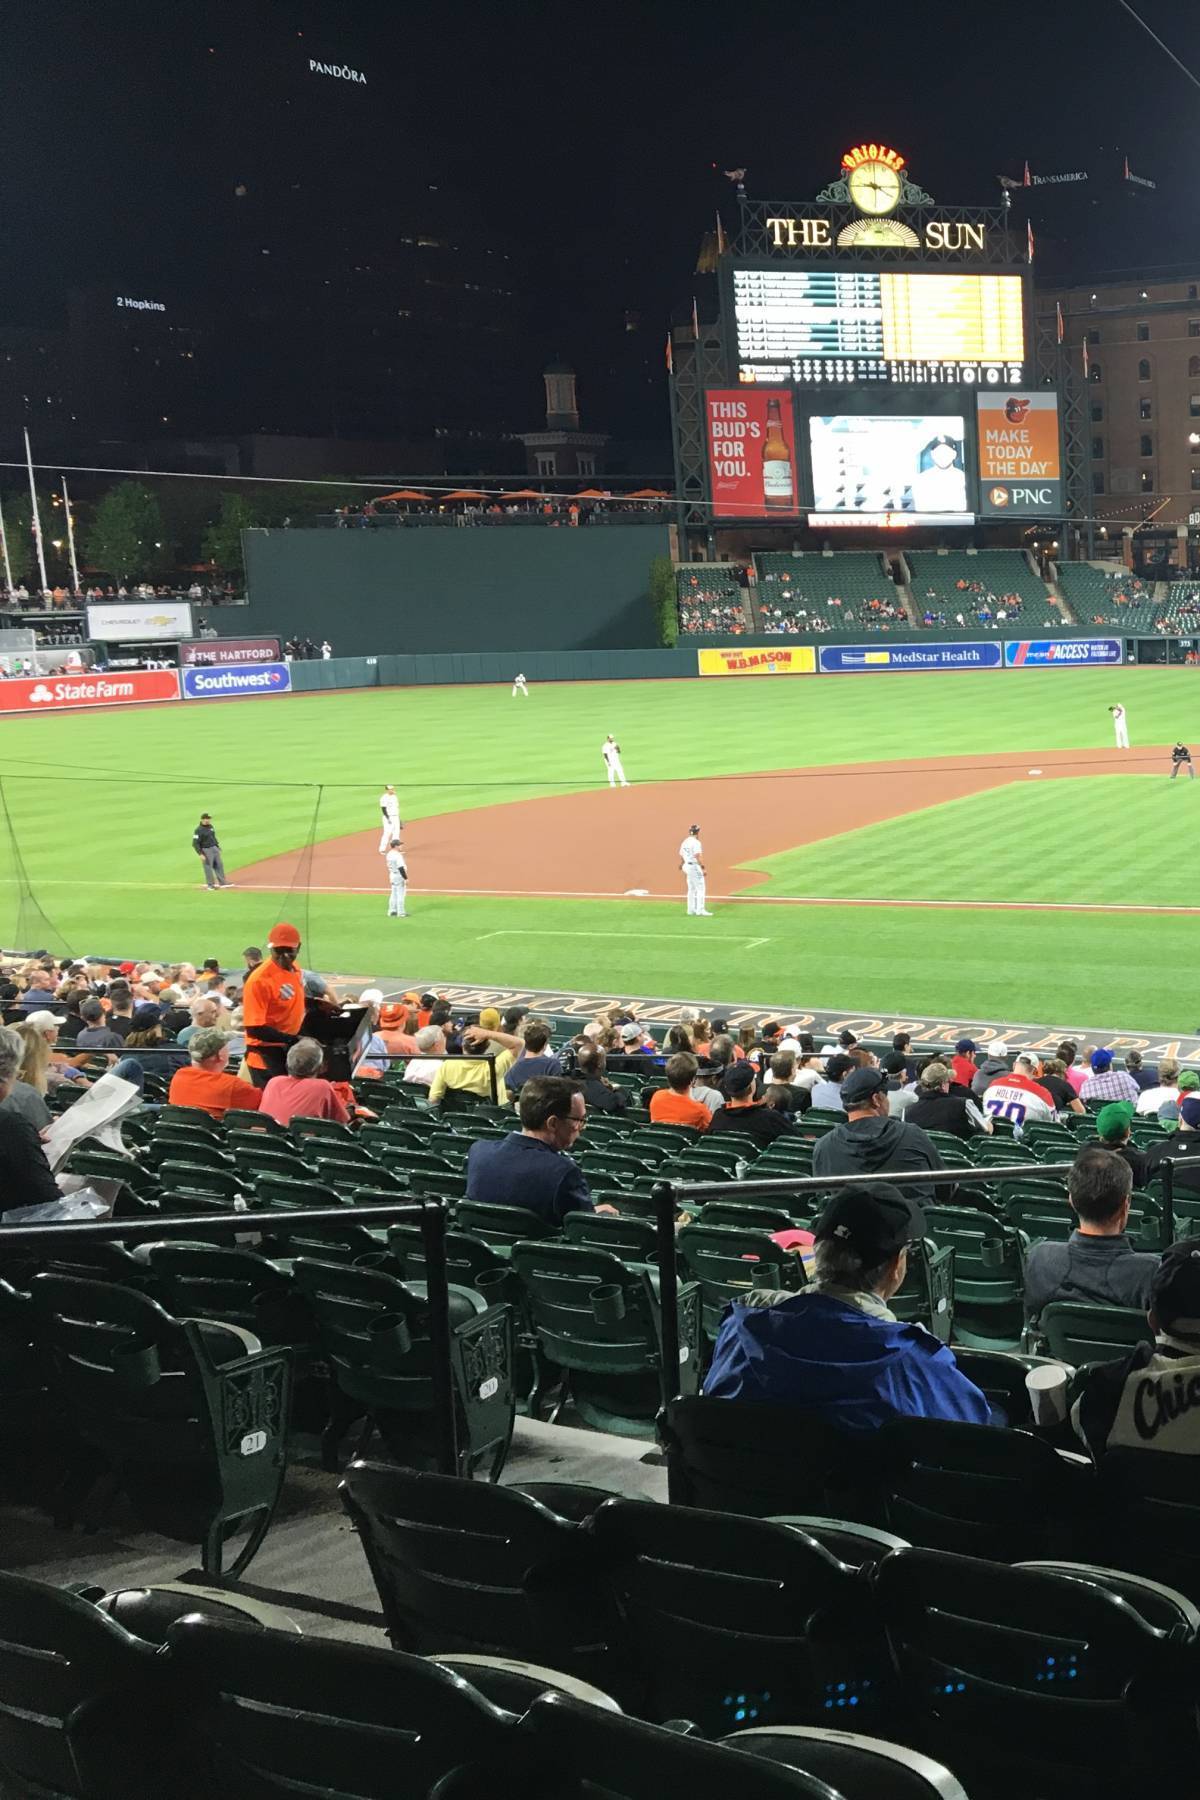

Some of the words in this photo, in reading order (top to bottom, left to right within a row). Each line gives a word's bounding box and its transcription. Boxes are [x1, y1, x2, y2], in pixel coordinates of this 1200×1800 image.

[309, 59, 367, 85] PANDORA
[843, 144, 905, 170] ORIOLES
[1031, 171, 1089, 186] TRANSAMERICA
[766, 218, 832, 247] THE
[925, 221, 985, 250] SUN
[116, 296, 124, 307] 2
[124, 297, 166, 311] Hopkins
[710, 402, 747, 418] THIS
[712, 421, 761, 438] BUD'S
[985, 430, 1030, 444] MAKE
[713, 441, 745, 457] FOR
[986, 446, 1034, 459] TODAY
[714, 461, 751, 477] YOU.
[987, 462, 1016, 475] THE
[1011, 488, 1053, 504] PNC
[220, 649, 274, 660] HARTFORD
[892, 651, 939, 663] MedStar
[941, 649, 980, 661] Health
[1053, 644, 1089, 659] ACCESS
[194, 672, 271, 690] Southwest
[726, 1010, 816, 1030] TO
[825, 1018, 1087, 1050] ORIOLE
[995, 1087, 1024, 1101] HOLTBY
[246, 1434, 260, 1452] 21
